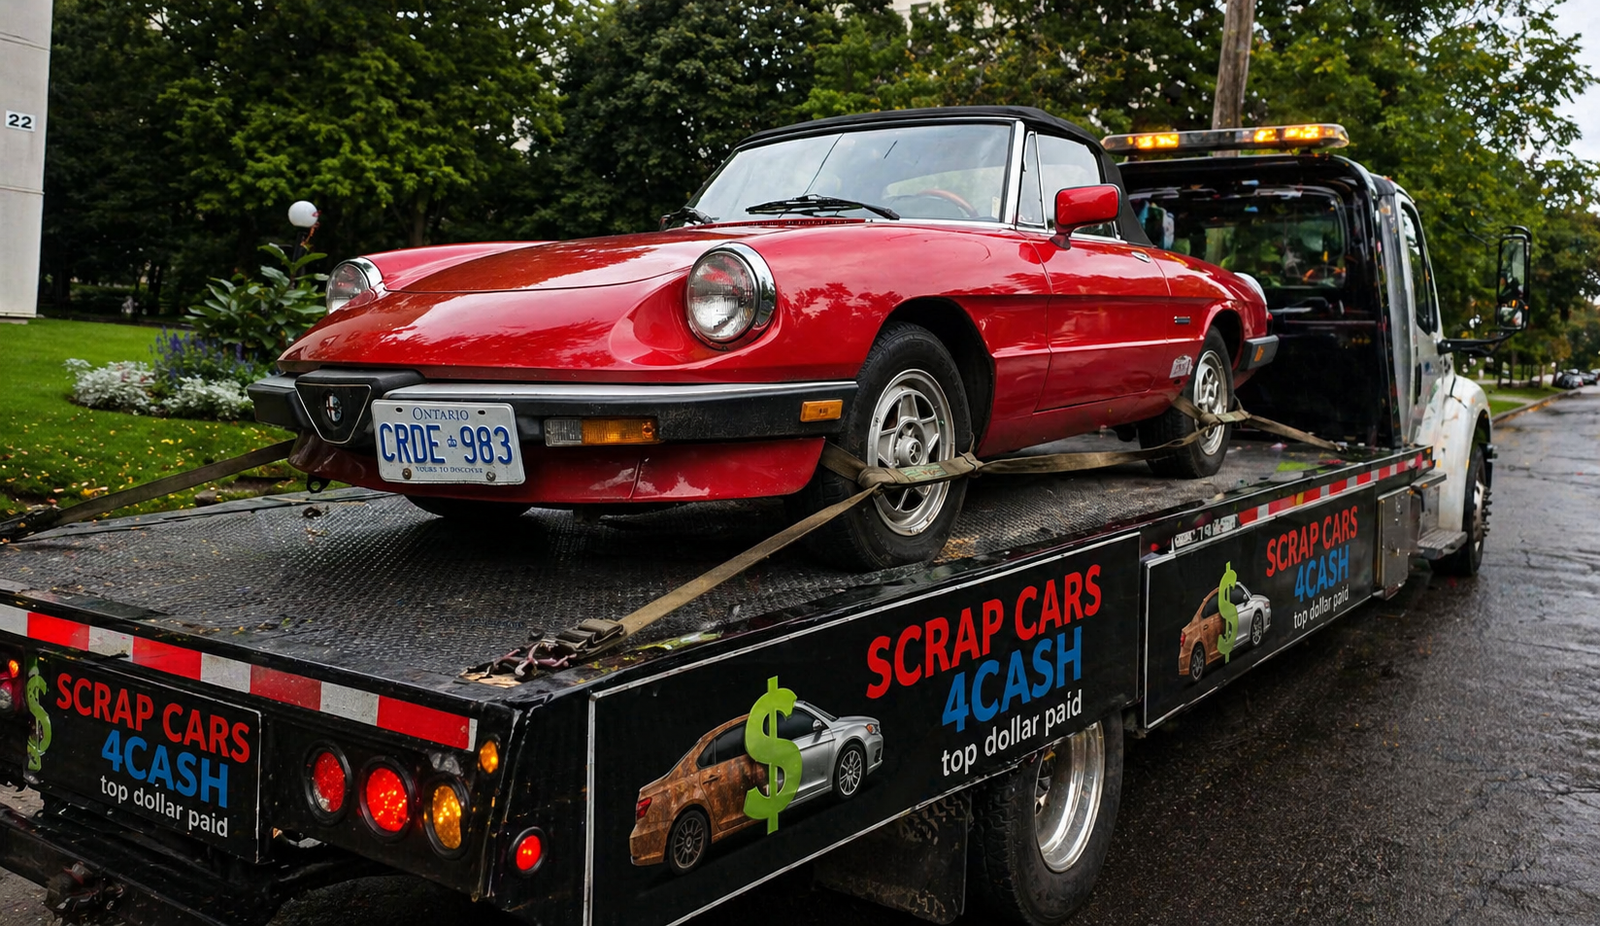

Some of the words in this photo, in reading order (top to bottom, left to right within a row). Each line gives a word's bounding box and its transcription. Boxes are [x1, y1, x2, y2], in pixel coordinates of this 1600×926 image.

[9, 114, 32, 129] 22
[379, 423, 446, 464] CRDE
[459, 426, 513, 464] 983
[1266, 521, 1319, 578] SCRAP
[1322, 505, 1358, 550] CARS
[1294, 545, 1349, 603] 4CASH
[866, 599, 1004, 699] SCRAP
[1015, 564, 1102, 641] CARS
[1294, 610, 1308, 630] top
[1309, 595, 1332, 621] dollar
[1333, 583, 1349, 613] paid
[942, 626, 1082, 733] 4CASH
[56, 673, 154, 732] SCRAP
[162, 703, 250, 763] CARS
[941, 743, 977, 776] top
[985, 714, 1040, 757] dollar
[1045, 689, 1082, 737] paid
[101, 729, 228, 808] 4CASH
[100, 775, 128, 804] top
[133, 788, 183, 820] dollar
[188, 809, 228, 838] paid
